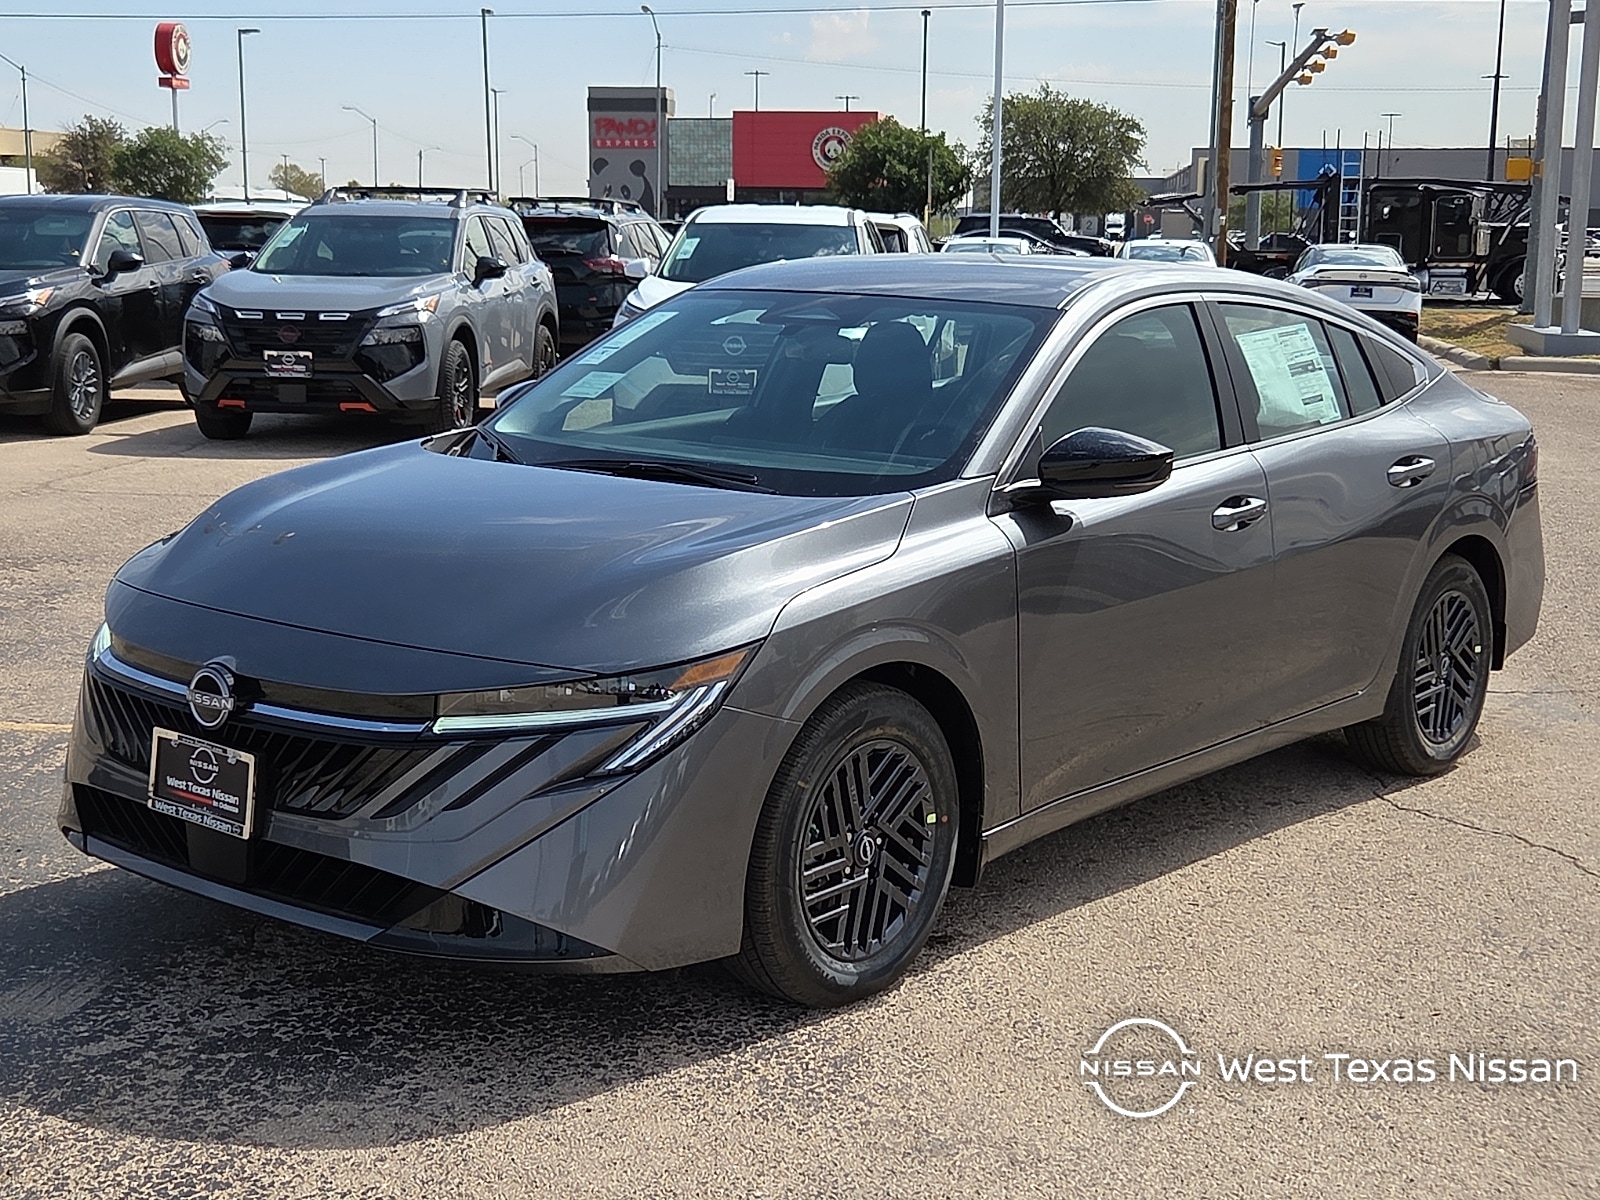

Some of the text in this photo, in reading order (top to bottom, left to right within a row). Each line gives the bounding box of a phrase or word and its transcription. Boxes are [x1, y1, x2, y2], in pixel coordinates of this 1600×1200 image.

[813, 130, 830, 150] PANDA
[1086, 220, 1093, 230] 2
[186, 690, 233, 710] NISSAN
[189, 759, 219, 772] NISSAN
[166, 776, 239, 805] West Texas Nissan
[155, 800, 176, 815] West
[178, 806, 202, 822] Texas
[203, 815, 232, 832] Nissan
